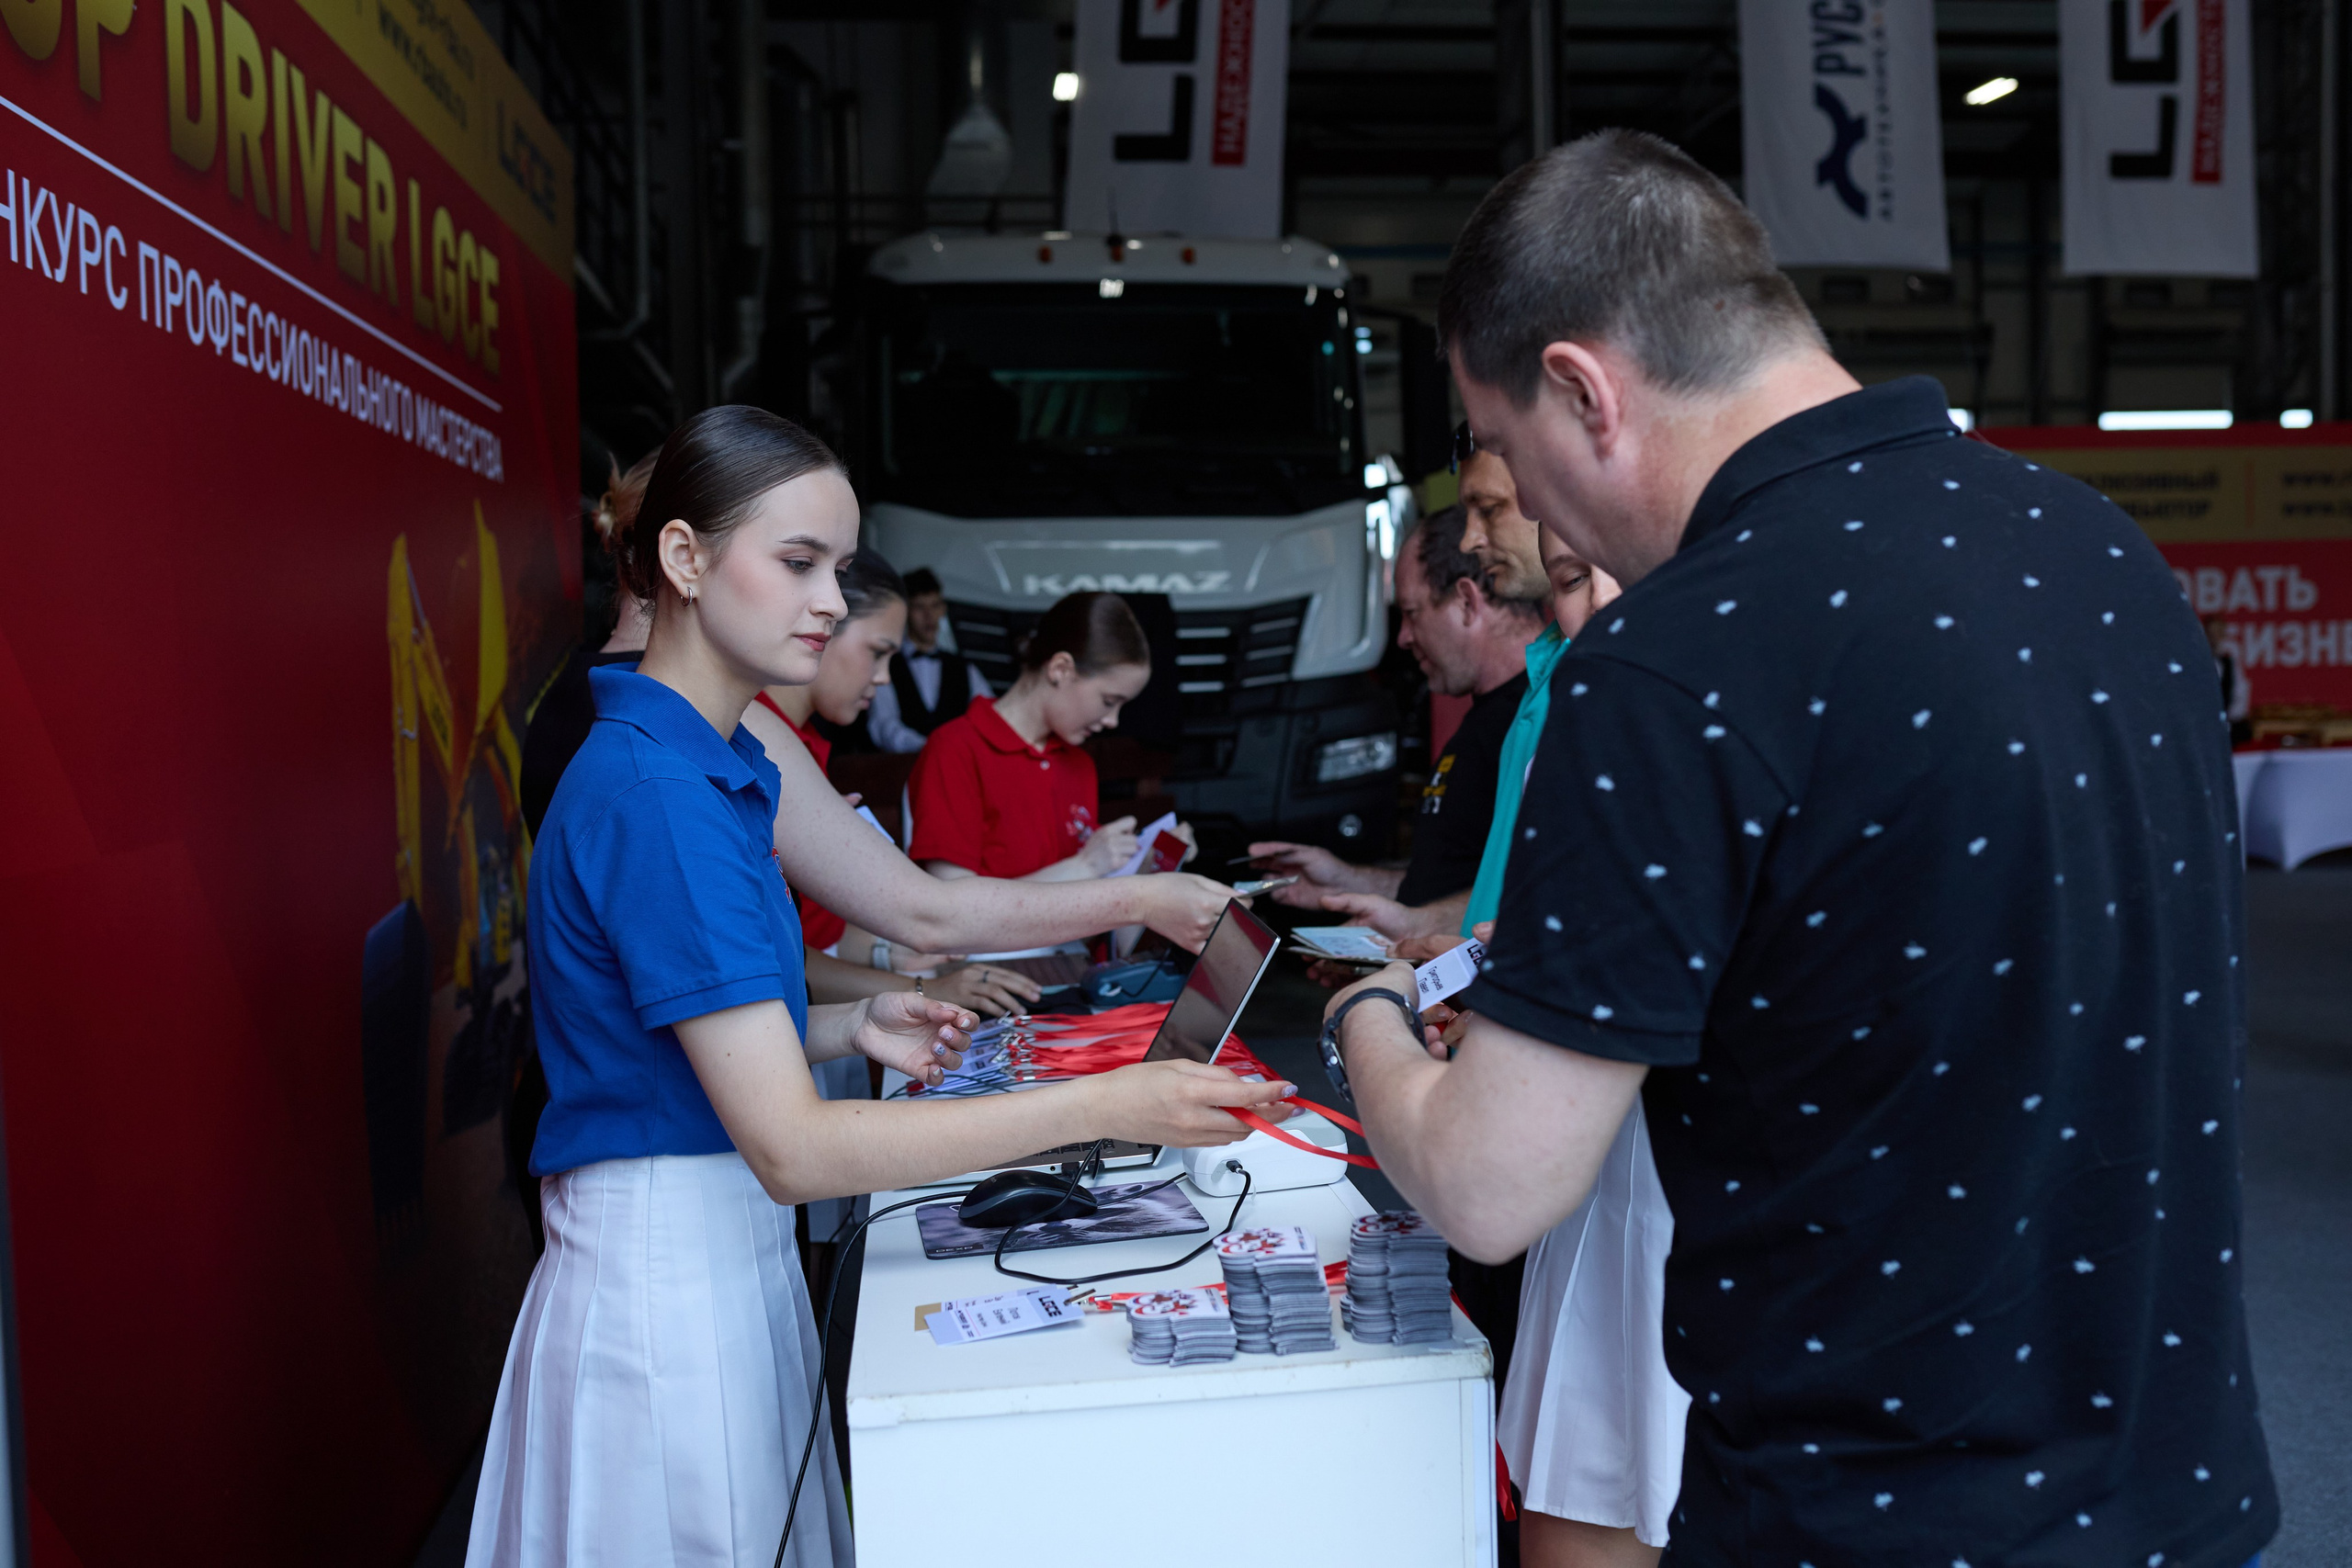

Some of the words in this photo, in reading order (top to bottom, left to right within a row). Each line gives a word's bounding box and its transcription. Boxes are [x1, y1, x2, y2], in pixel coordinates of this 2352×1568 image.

[164, 0, 400, 309] DRIVER
[407, 176, 503, 378] LGCE
[138, 240, 414, 444] ПРОФЕССИОНАЛЬНОГО
[415, 391, 505, 484] МАСТЕРСТВА
[1023, 570, 1232, 596] KAMAZ
[1038, 1295, 1063, 1317] LGCE
